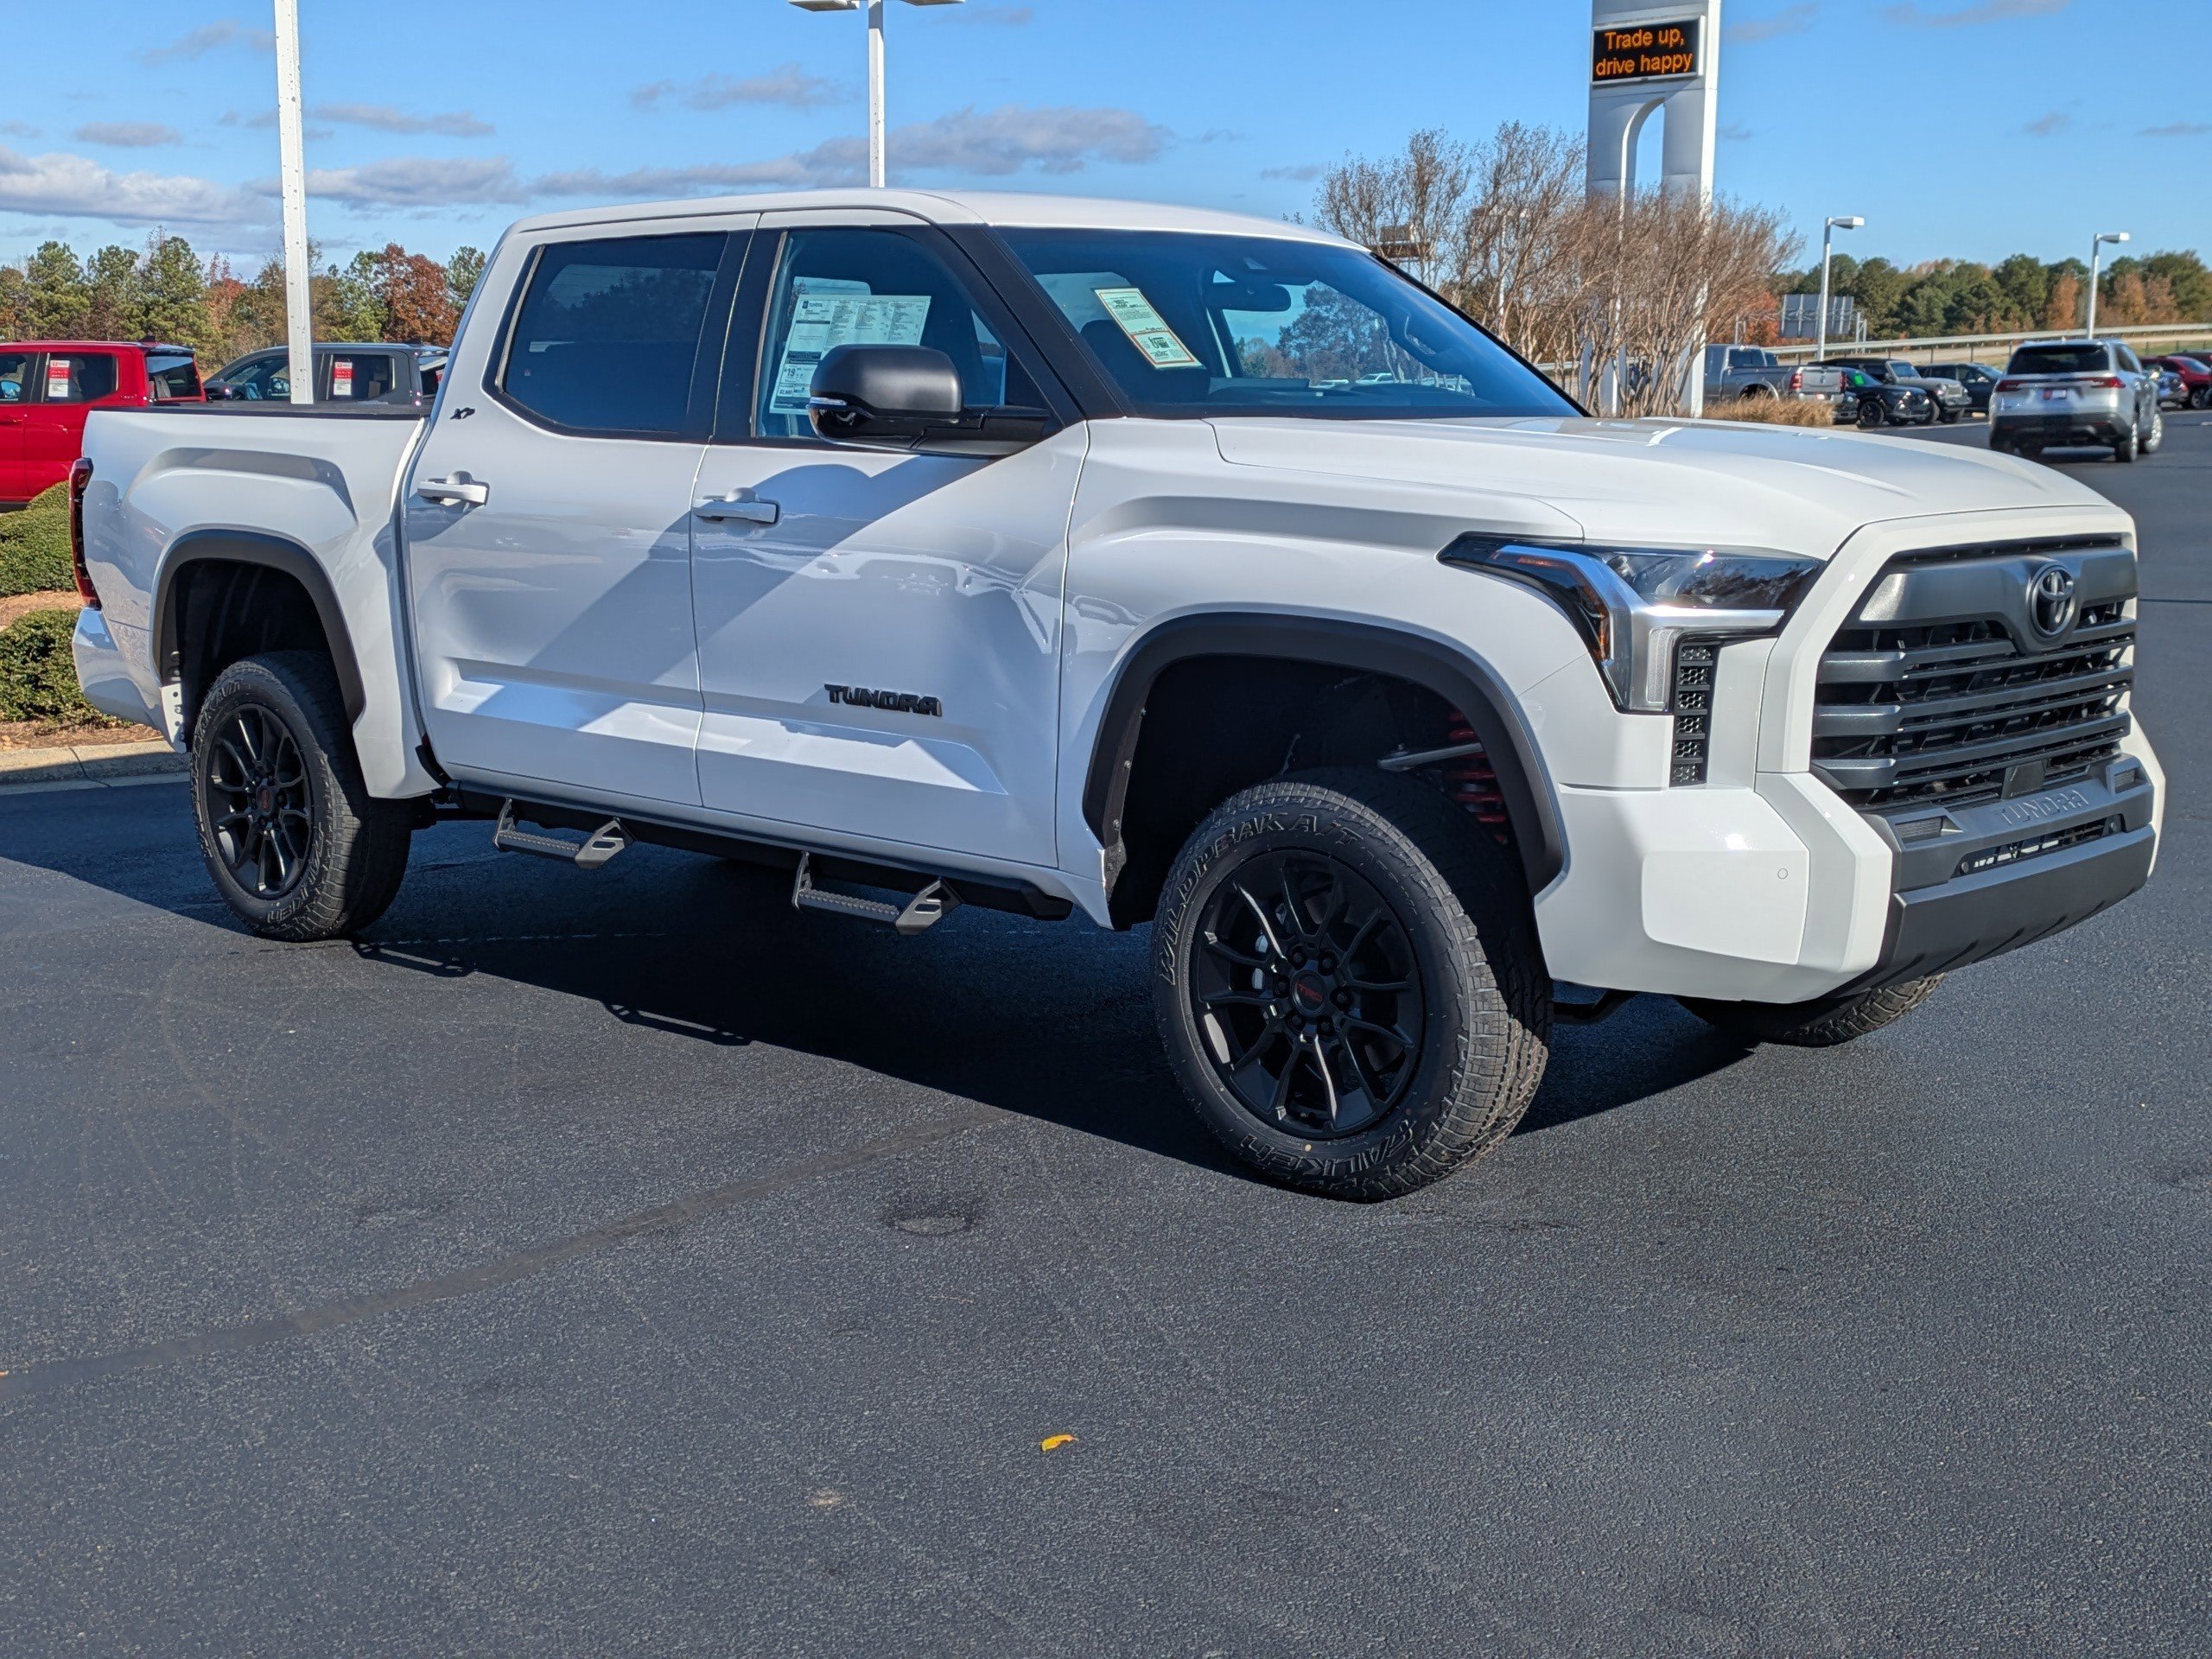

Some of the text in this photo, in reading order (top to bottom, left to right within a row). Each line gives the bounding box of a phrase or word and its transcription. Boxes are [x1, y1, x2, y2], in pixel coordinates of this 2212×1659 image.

[1605, 28, 1685, 50] Trade up,
[1595, 53, 1694, 76] drive happy
[823, 683, 943, 717] TUNDRA
[1993, 789, 2089, 825] TUNDRA
[1160, 812, 1287, 986] WILDPEAK
